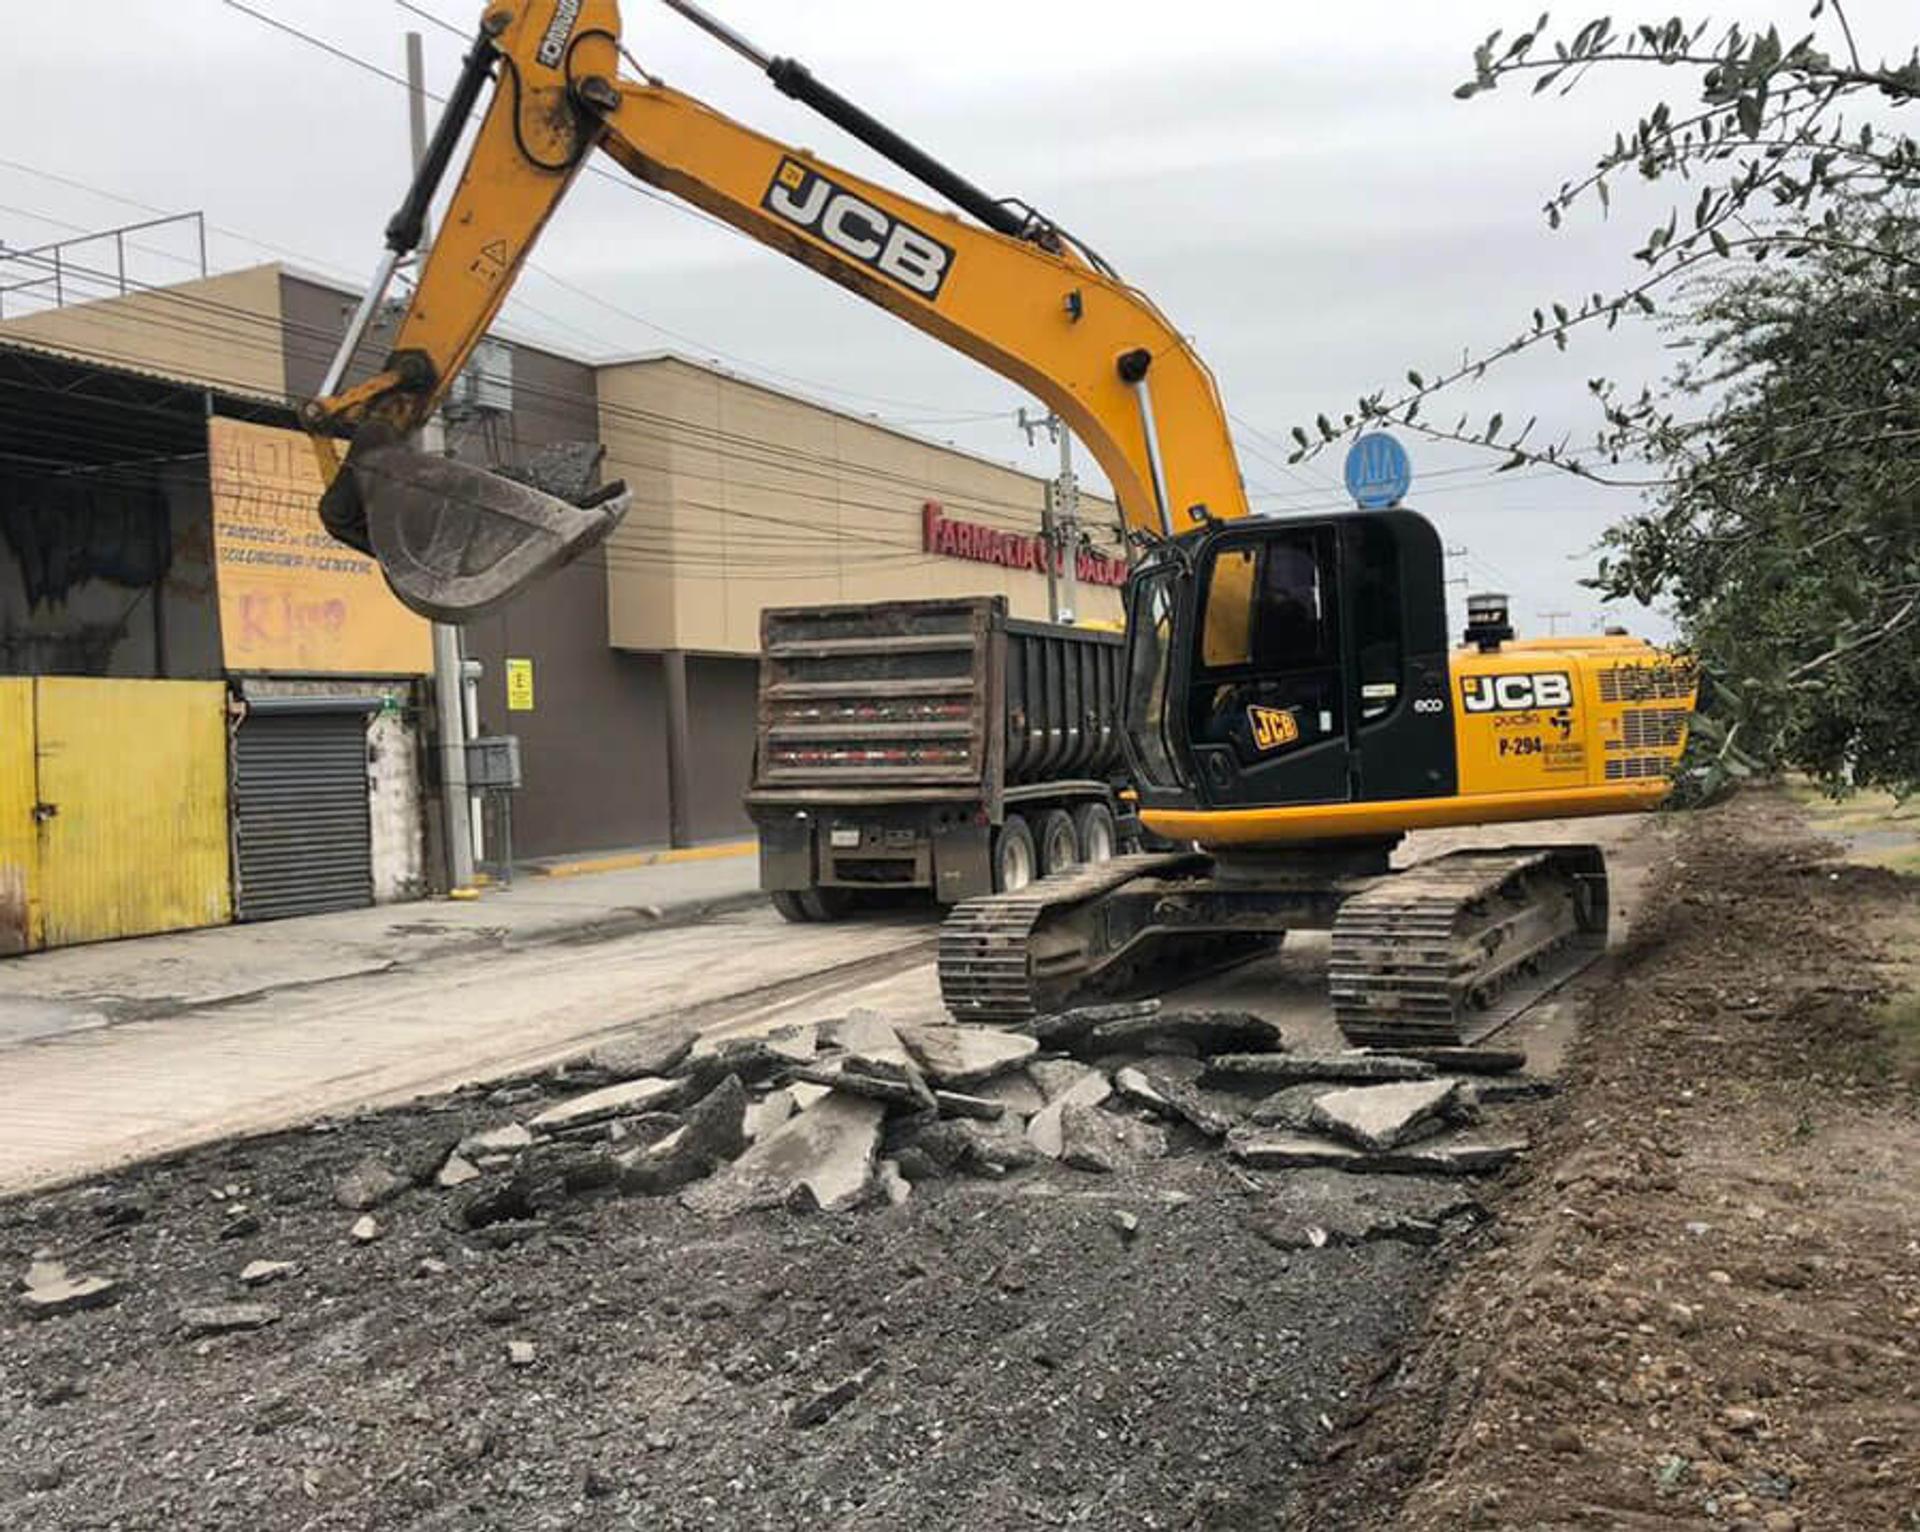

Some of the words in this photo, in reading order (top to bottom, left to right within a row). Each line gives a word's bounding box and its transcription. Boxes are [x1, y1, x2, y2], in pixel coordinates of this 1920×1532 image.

[769, 178, 947, 293] JCB
[922, 497, 1036, 570] FARMACIA
[1464, 674, 1572, 711] JCB
[1256, 709, 1297, 744] JCB
[1499, 735, 1542, 757] P-294
